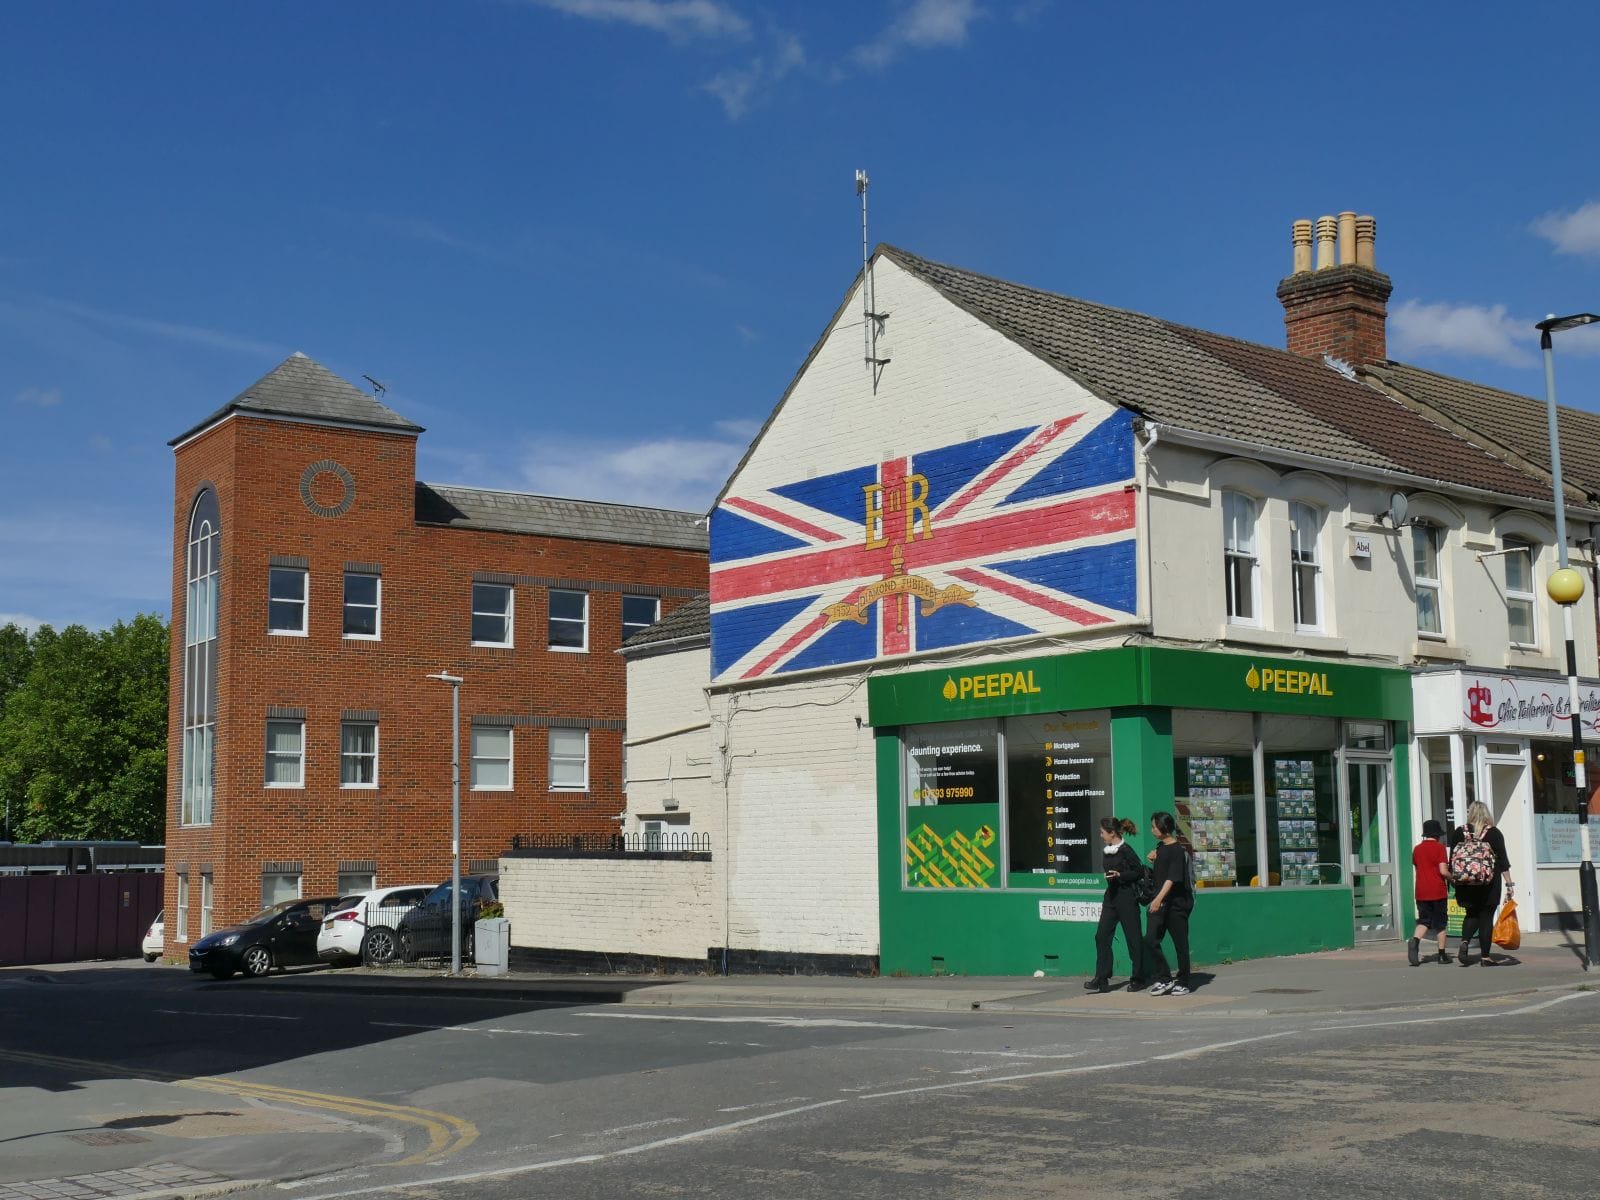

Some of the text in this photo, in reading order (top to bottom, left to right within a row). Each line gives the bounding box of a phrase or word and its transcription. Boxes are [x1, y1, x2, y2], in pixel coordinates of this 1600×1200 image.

[1356, 541, 1370, 552] Abel
[860, 580, 896, 607] DIAMOND
[901, 578, 937, 600] JUBILEE
[960, 670, 1041, 700] PEEPAL
[1262, 668, 1334, 696] PEEPAL
[1497, 697, 1517, 722] Chic
[1518, 695, 1553, 729] Tailoring
[1556, 696, 1563, 712] &
[911, 743, 983, 757] daunting experience.
[1054, 742, 1080, 750] Mortgages
[1054, 773, 1080, 781] Protection
[946, 787, 974, 798] 975990
[1055, 838, 1088, 846] Management
[1041, 905, 1102, 917] TEMPLE STRE
